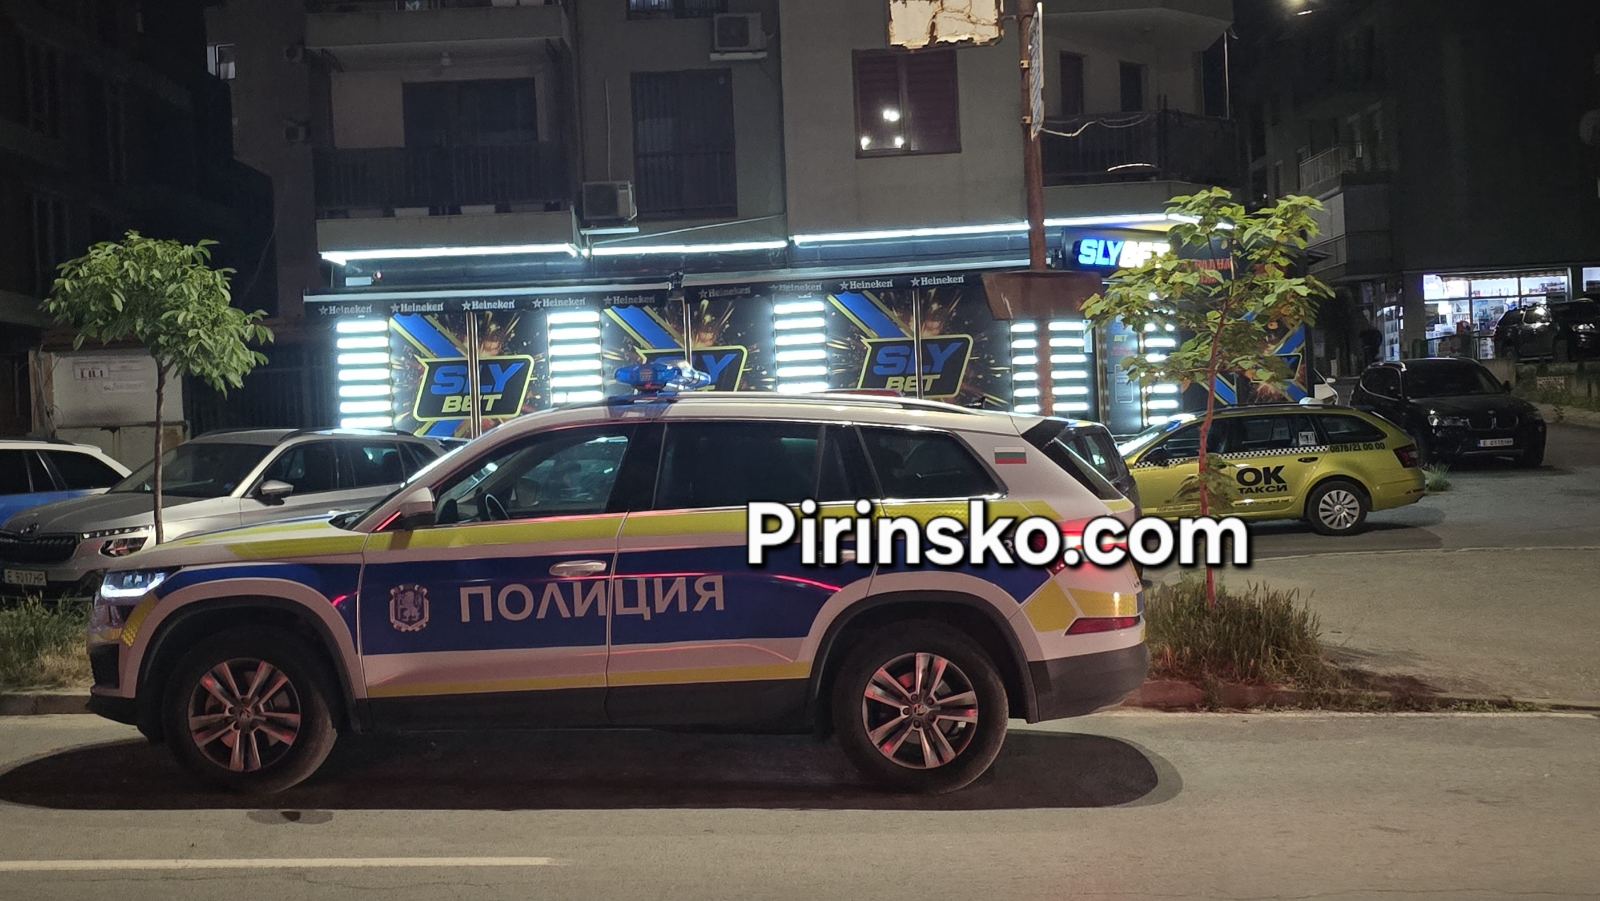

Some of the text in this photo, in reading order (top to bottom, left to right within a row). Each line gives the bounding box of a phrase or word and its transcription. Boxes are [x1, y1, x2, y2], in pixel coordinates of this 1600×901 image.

[708, 275, 965, 298] Heineken Heineken Heineken Heineken
[329, 295, 655, 314] Heineken Heineken Heineken Heineken Heineken
[873, 342, 964, 375] SLY
[885, 374, 941, 392] BET
[1238, 484, 1288, 494] ТАКСИ
[459, 575, 725, 622] ПОЛИЦИЯ
